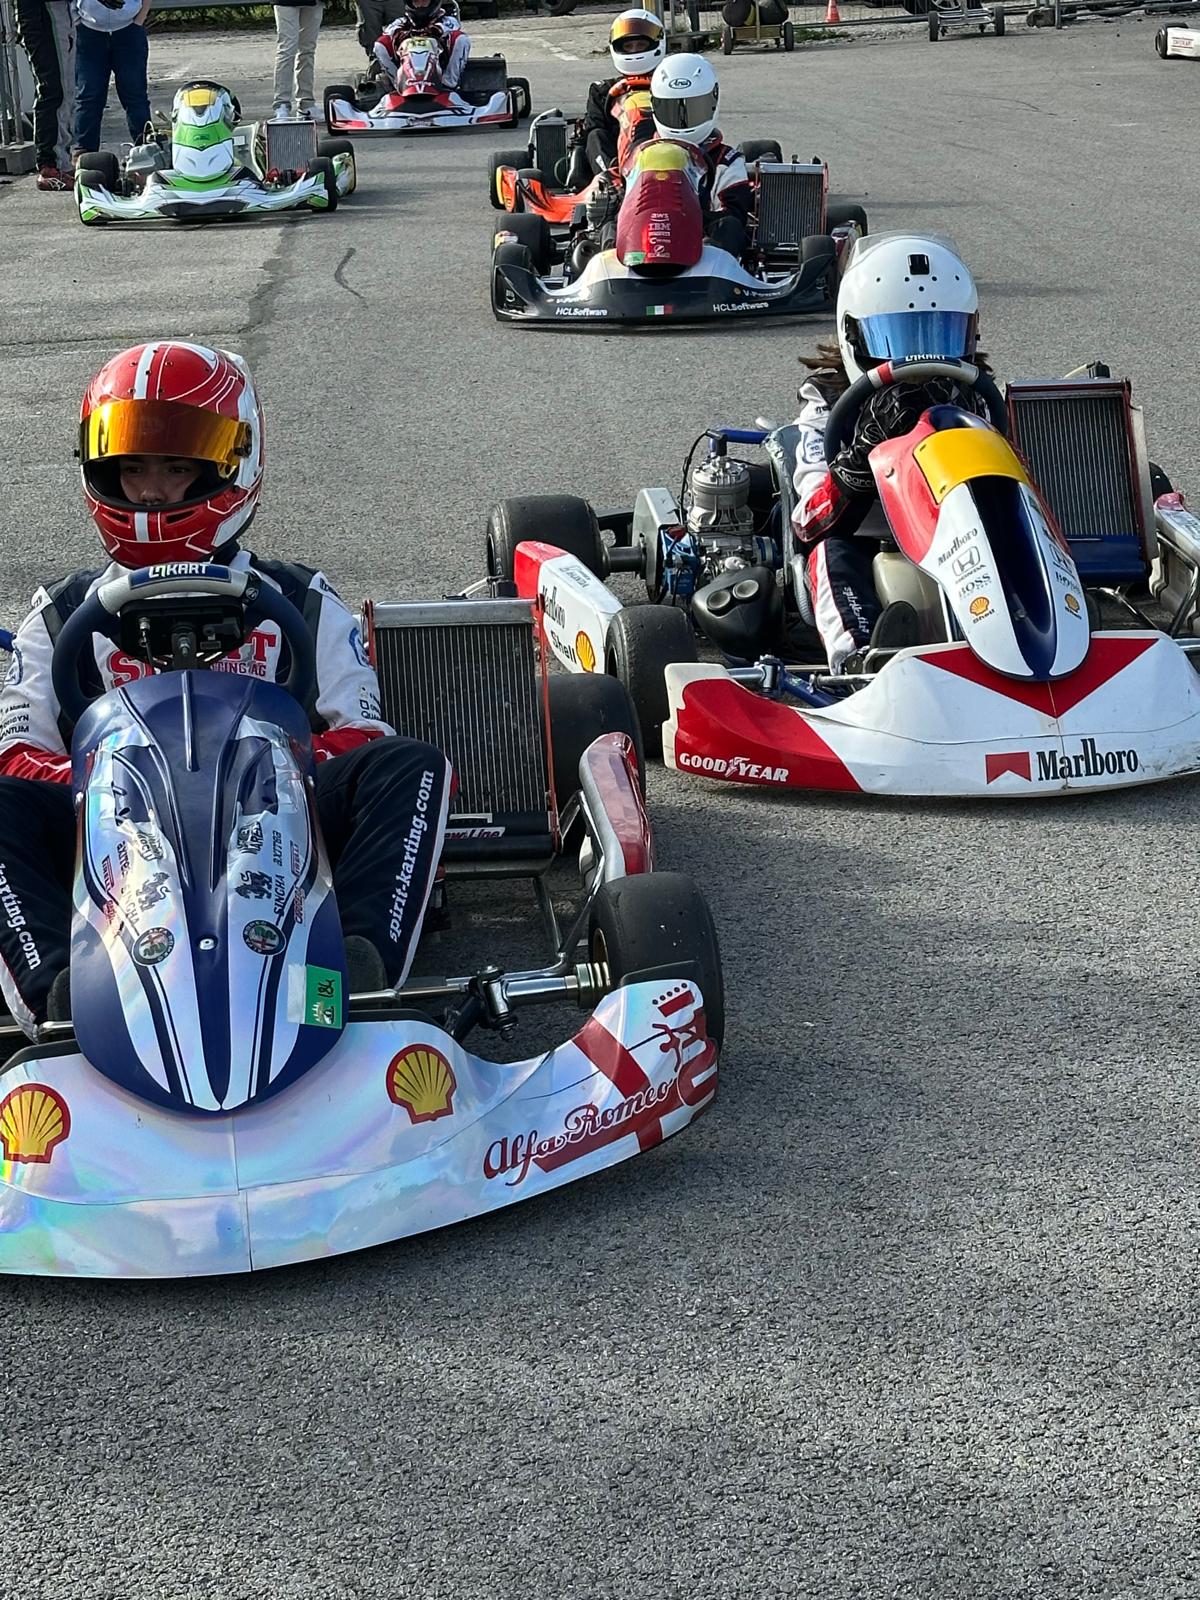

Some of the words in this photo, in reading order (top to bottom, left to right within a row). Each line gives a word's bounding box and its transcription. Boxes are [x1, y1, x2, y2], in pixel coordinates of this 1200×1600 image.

[648, 223, 671, 231] IBM
[651, 213, 669, 221] aws
[555, 307, 608, 316] HCLSoftware
[712, 302, 769, 312] HCLSoftware
[938, 528, 979, 566] Marlboro
[958, 573, 991, 597] BOSS
[551, 629, 577, 665] Shell
[251, 663, 267, 677] AG
[1036, 738, 1139, 782] Marlboro
[389, 769, 434, 943] spirit-karting.com
[273, 874, 285, 915] SINGHA
[564, 1078, 676, 1140] Romeo
